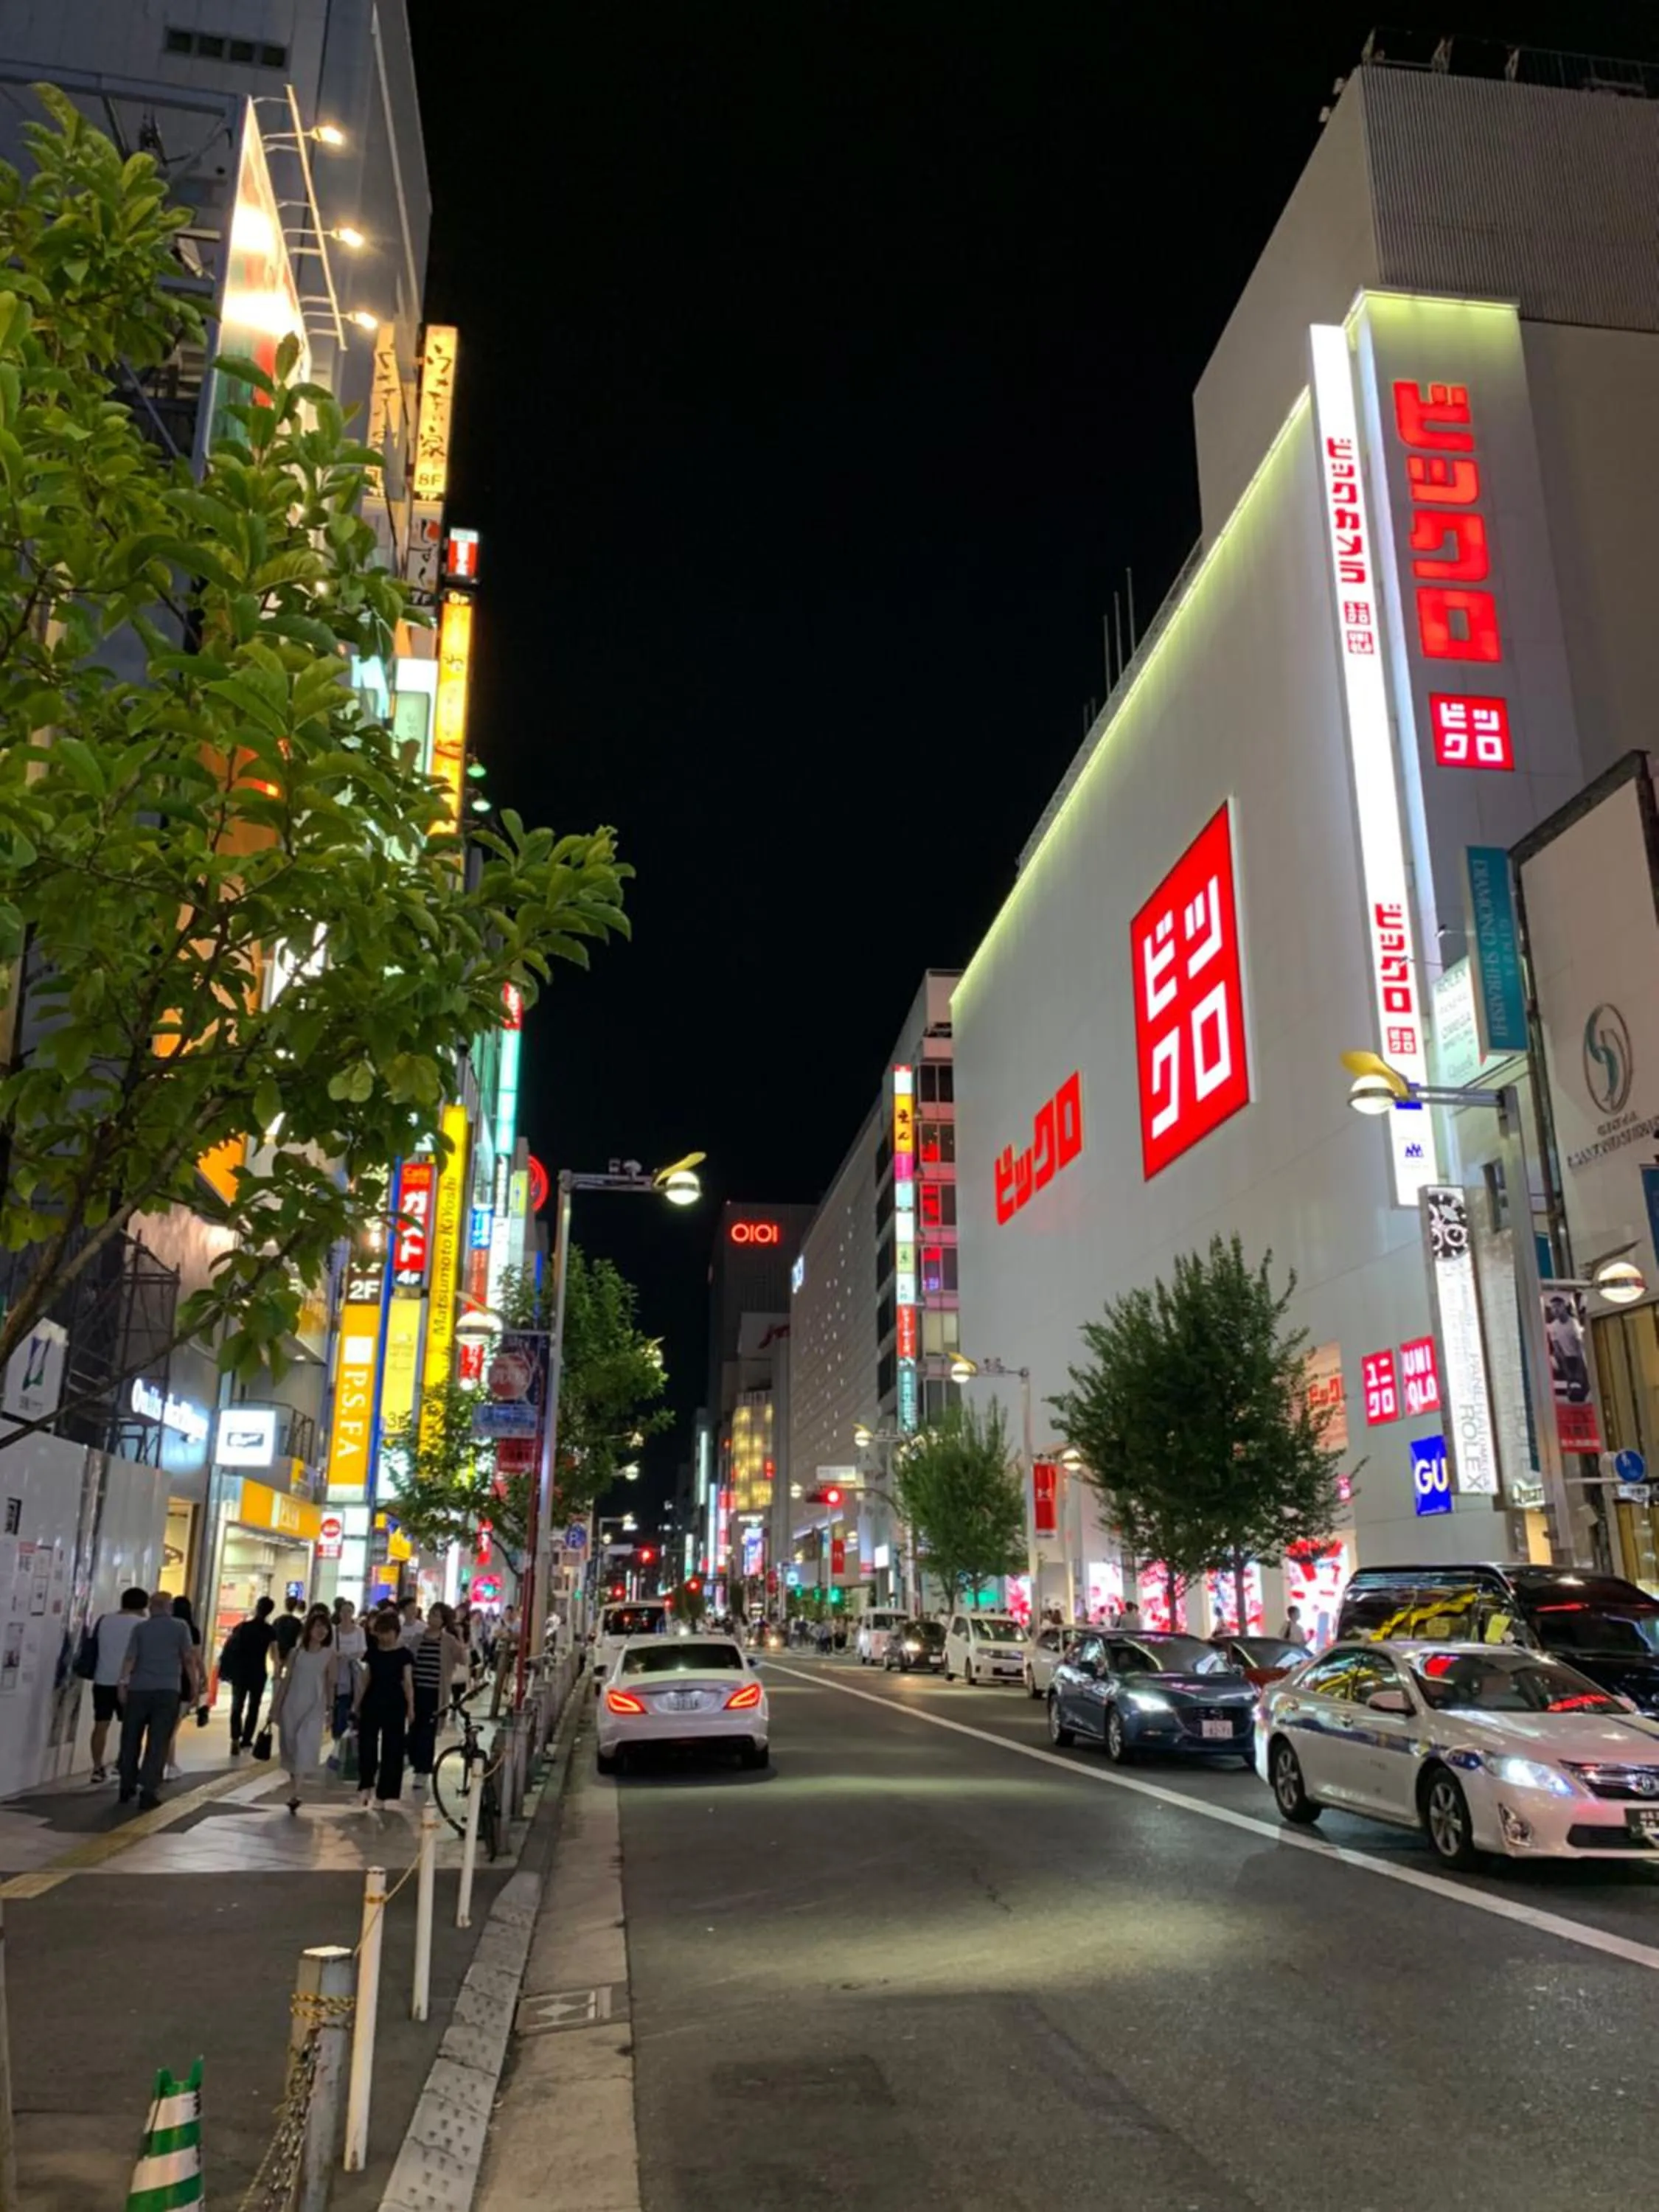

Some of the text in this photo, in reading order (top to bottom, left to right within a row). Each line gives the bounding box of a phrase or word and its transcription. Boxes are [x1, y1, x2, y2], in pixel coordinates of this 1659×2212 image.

[418, 474, 442, 487] 8F
[1326, 437, 1366, 585] ビックカメラ
[1393, 380, 1501, 661] ビックロ
[1374, 903, 1412, 1013] ビックロ
[995, 1069, 1082, 1226] ビックロ
[348, 1280, 380, 1300] 2F
[397, 1268, 422, 1284] 4F
[434, 1239, 453, 1336] Matsumoto
[1402, 1345, 1433, 1377] UNI
[1407, 1374, 1438, 1410] QLO
[1414, 1458, 1449, 1495] GU
[1459, 1404, 1482, 1490] ROLEX
